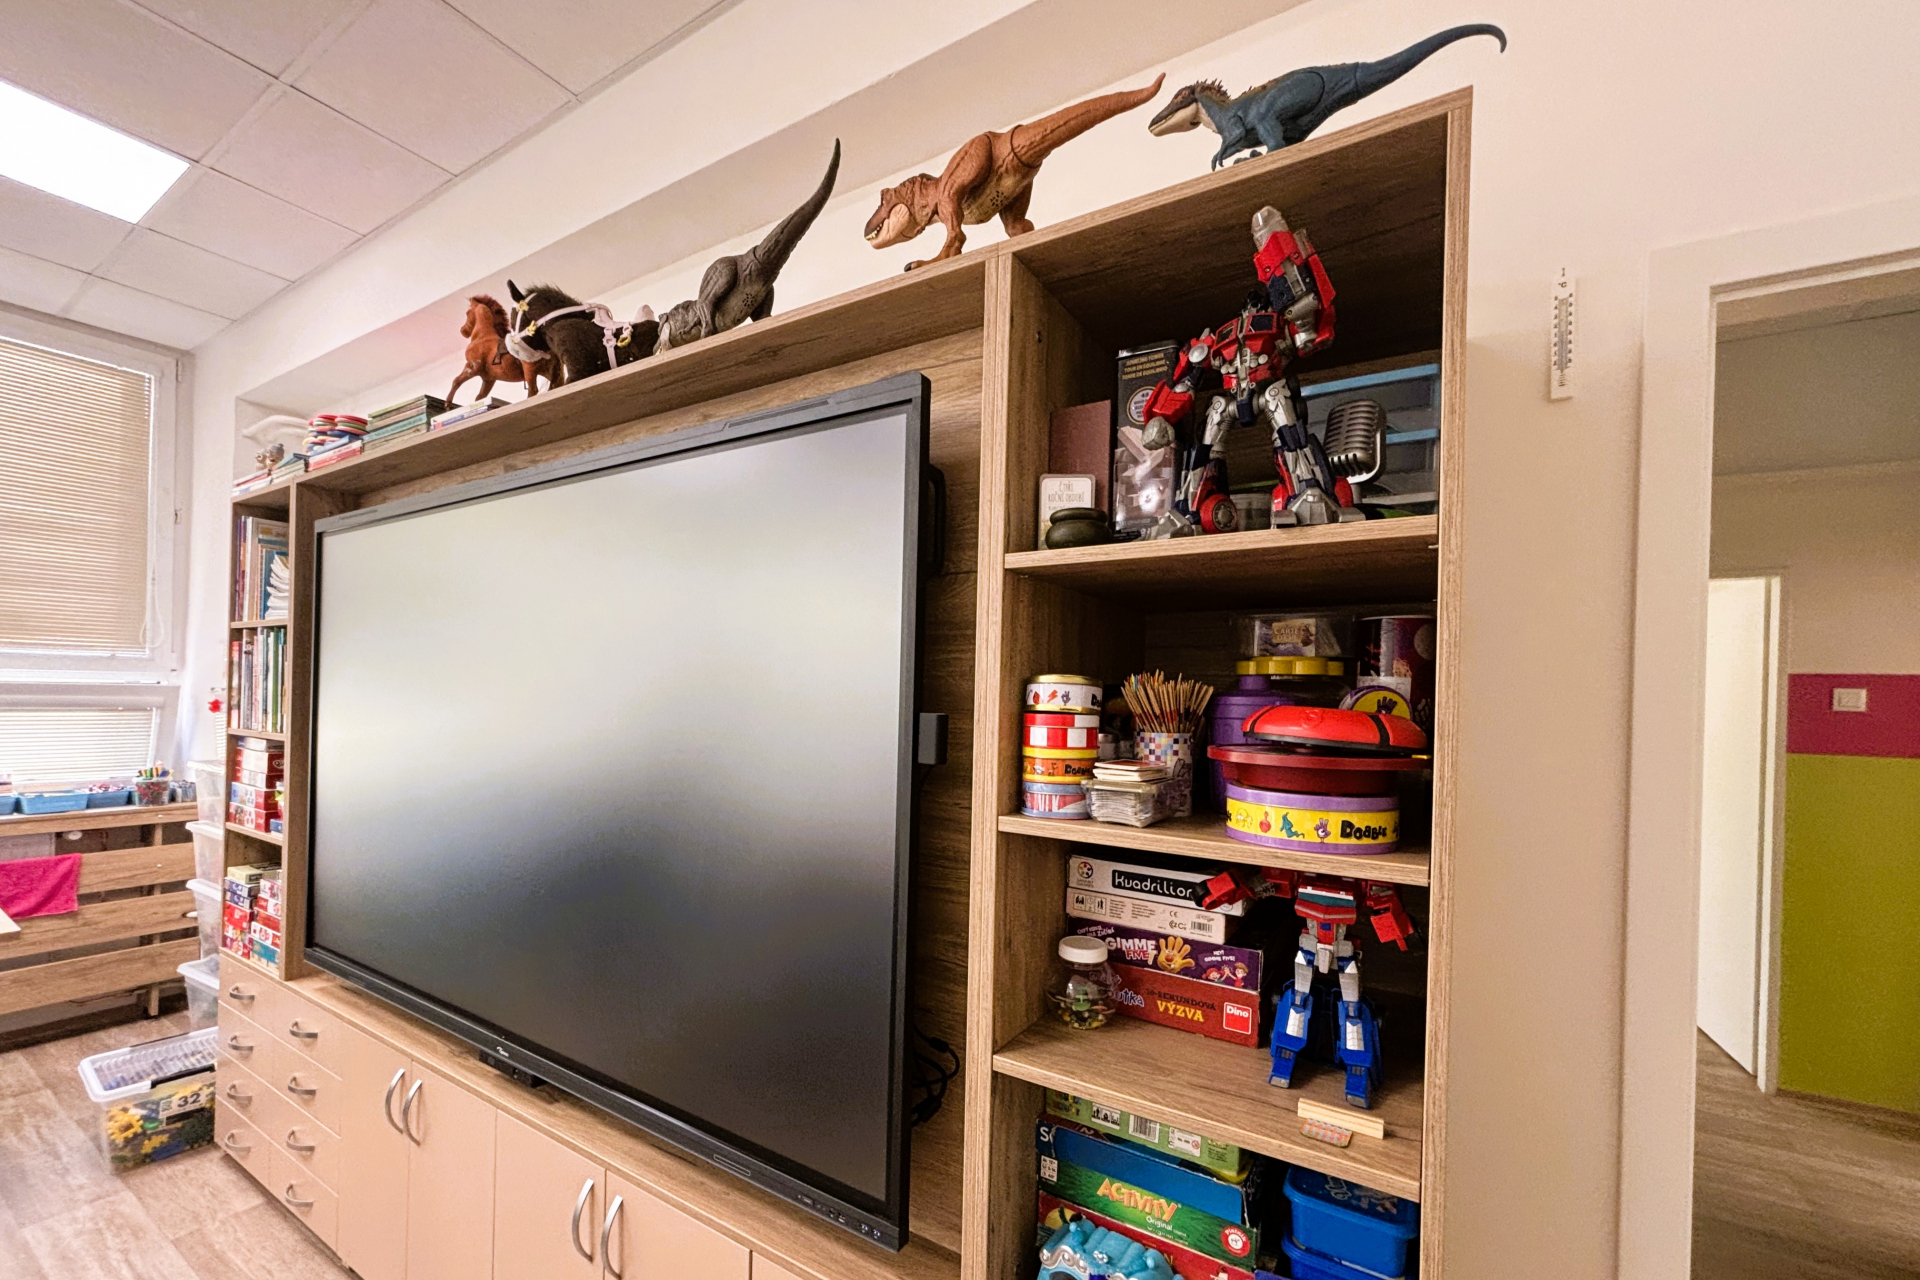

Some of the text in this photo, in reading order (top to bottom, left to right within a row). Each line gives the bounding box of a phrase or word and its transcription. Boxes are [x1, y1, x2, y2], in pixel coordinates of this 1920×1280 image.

[1105, 937, 1156, 953] GIMME
[1157, 1000, 1205, 1022] VÝZVA
[1226, 1005, 1249, 1018] Dino
[177, 1092, 201, 1108] 32
[1146, 1215, 1173, 1231] Original
[1224, 1227, 1247, 1242] Piatnik
